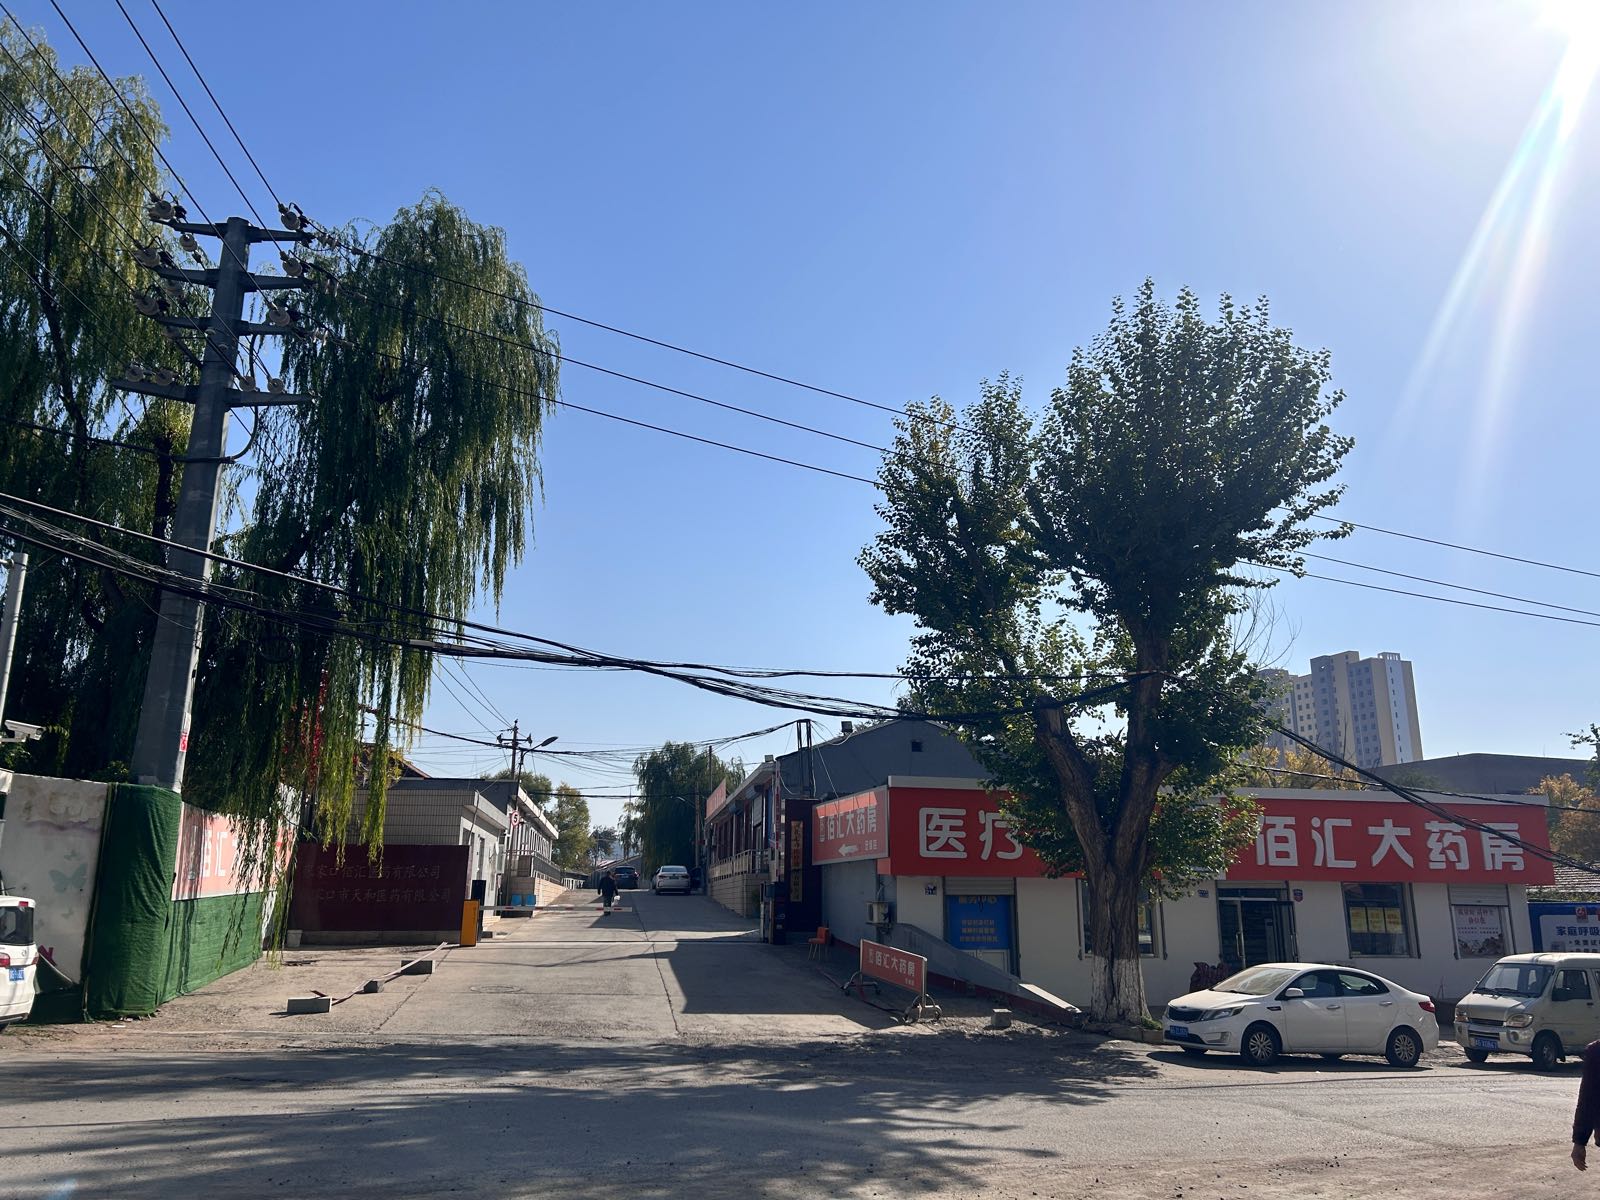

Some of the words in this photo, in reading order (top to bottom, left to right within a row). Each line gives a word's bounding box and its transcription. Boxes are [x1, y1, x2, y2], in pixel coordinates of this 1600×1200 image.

[827, 807, 877, 840] 佰汇大药房
[1256, 815, 1526, 872] 佰汇大药房
